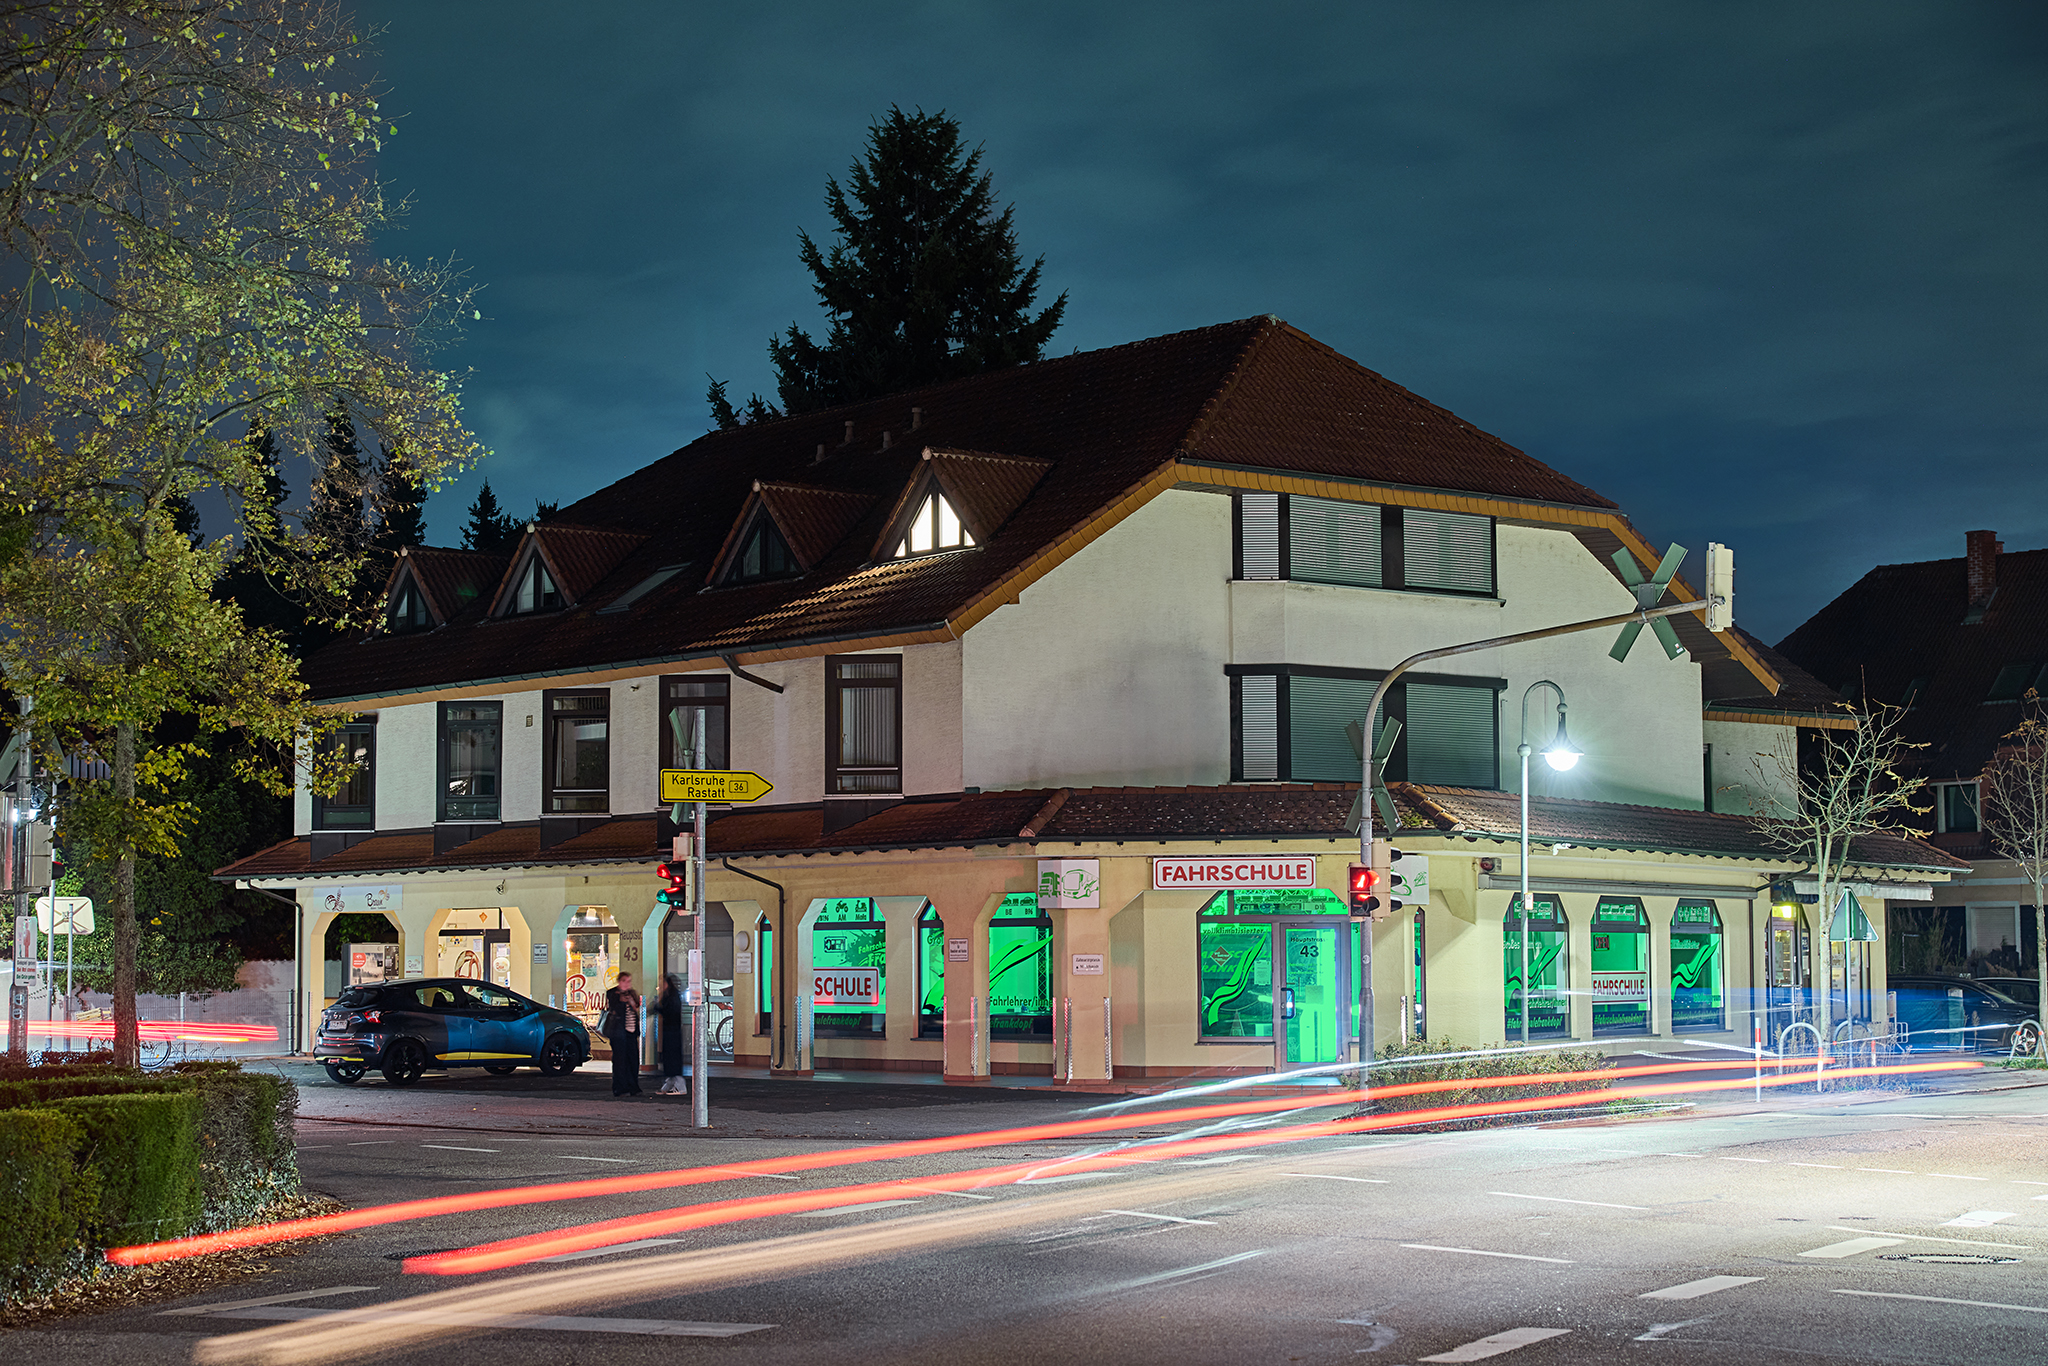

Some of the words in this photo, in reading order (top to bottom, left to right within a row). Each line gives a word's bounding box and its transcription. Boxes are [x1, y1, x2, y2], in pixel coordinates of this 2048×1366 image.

[671, 774, 725, 786] Karlsruhe
[733, 783, 744, 791] 36
[687, 787, 726, 798] Rastatt
[1162, 864, 1307, 882] FAHRSCHULE
[623, 946, 639, 962] 43
[1300, 945, 1320, 958] 43
[814, 976, 872, 996] SCHULE
[1593, 979, 1645, 996] FAHRSCHULE
